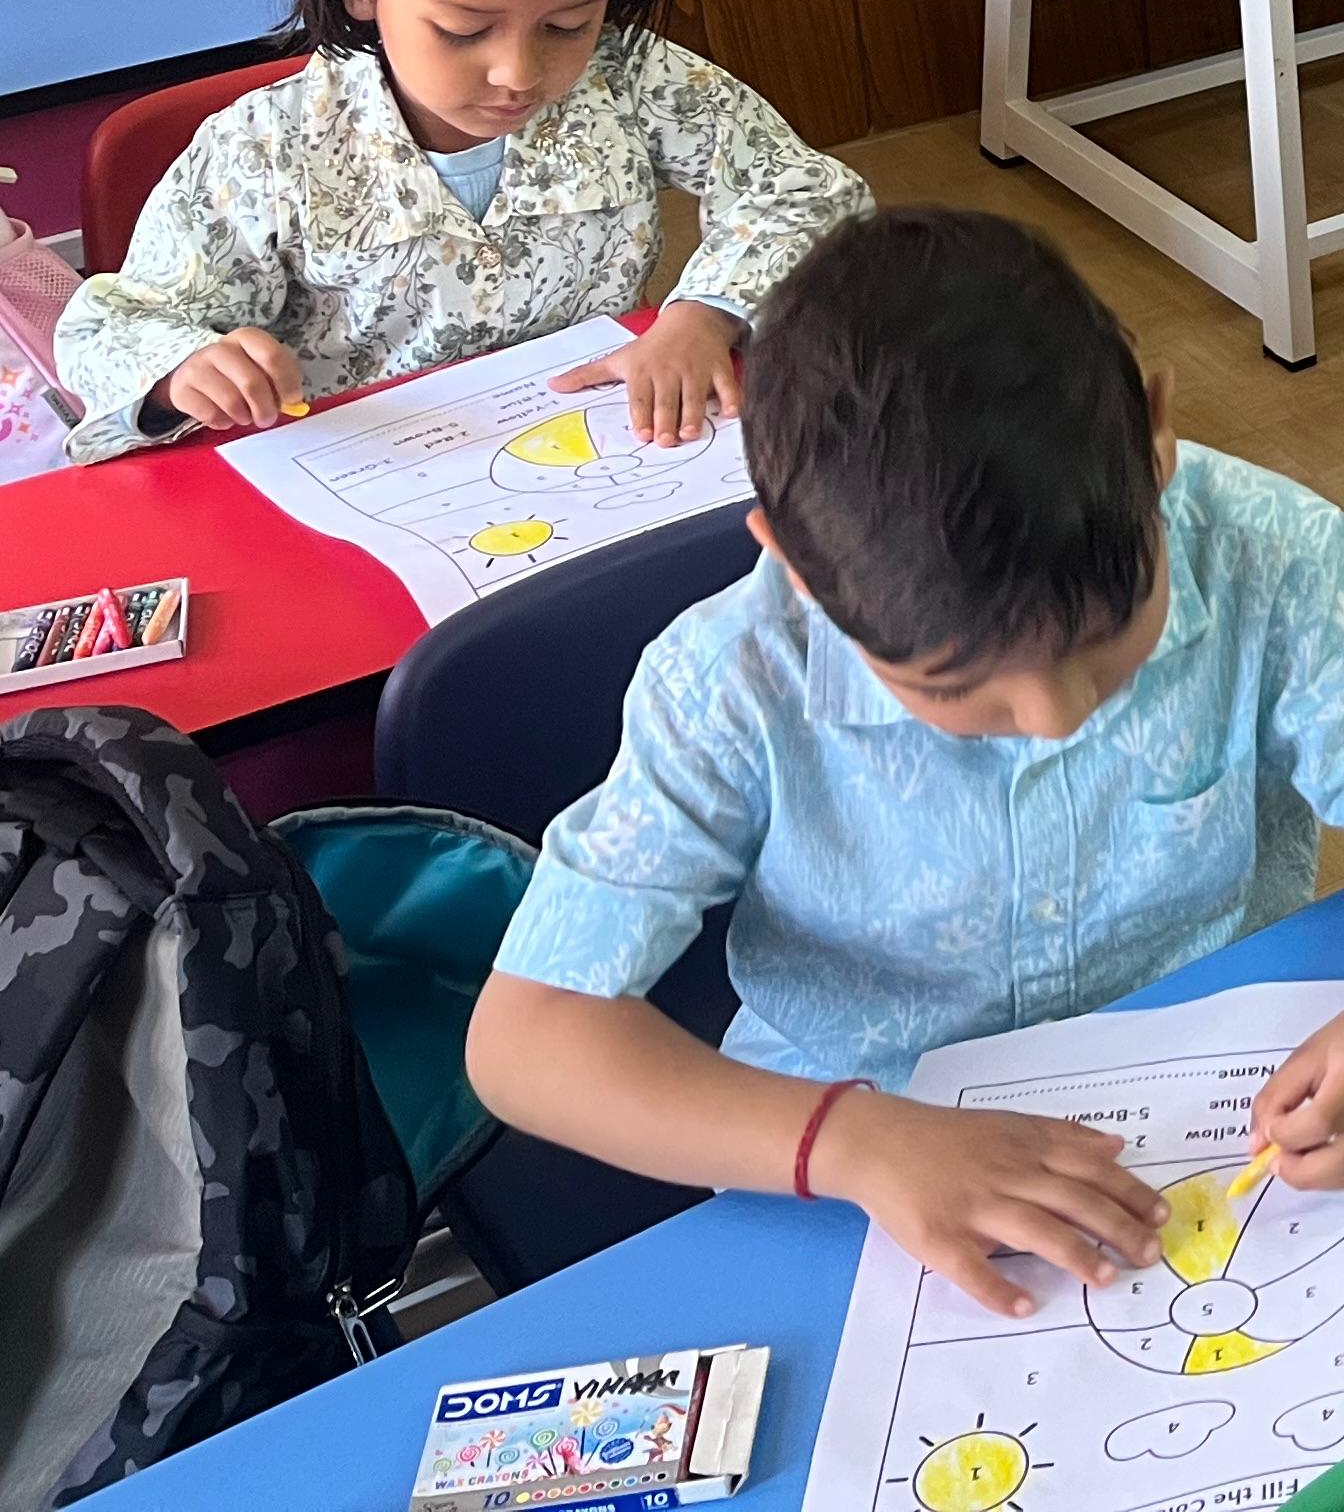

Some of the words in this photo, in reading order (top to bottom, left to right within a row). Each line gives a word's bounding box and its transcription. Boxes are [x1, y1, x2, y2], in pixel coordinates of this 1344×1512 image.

[1218, 1064, 1275, 1079] Name
[1209, 1097, 1250, 1110] Blue
[1185, 1124, 1250, 1141] Yellow
[1196, 1219, 1205, 1233] 1
[1289, 1222, 1300, 1234] 2
[1131, 1282, 1143, 1294] 3
[1305, 1286, 1315, 1299] 3
[1202, 1304, 1213, 1316] 5
[1140, 1337, 1152, 1350] 2
[1214, 1348, 1223, 1362] 1
[1334, 1353, 1344, 1367] 3
[1026, 1372, 1038, 1386] 3
[443, 1382, 559, 1419] DOMS
[1322, 1409, 1335, 1421] 4
[1168, 1422, 1180, 1434] 4
[435, 1478, 464, 1490] WAX
[468, 1470, 529, 1486] CRAYONS
[971, 1467, 982, 1481] 1
[1215, 1487, 1252, 1505] the
[1262, 1479, 1298, 1500] Fill
[482, 1492, 511, 1508] 10
[642, 1493, 668, 1507] 10
